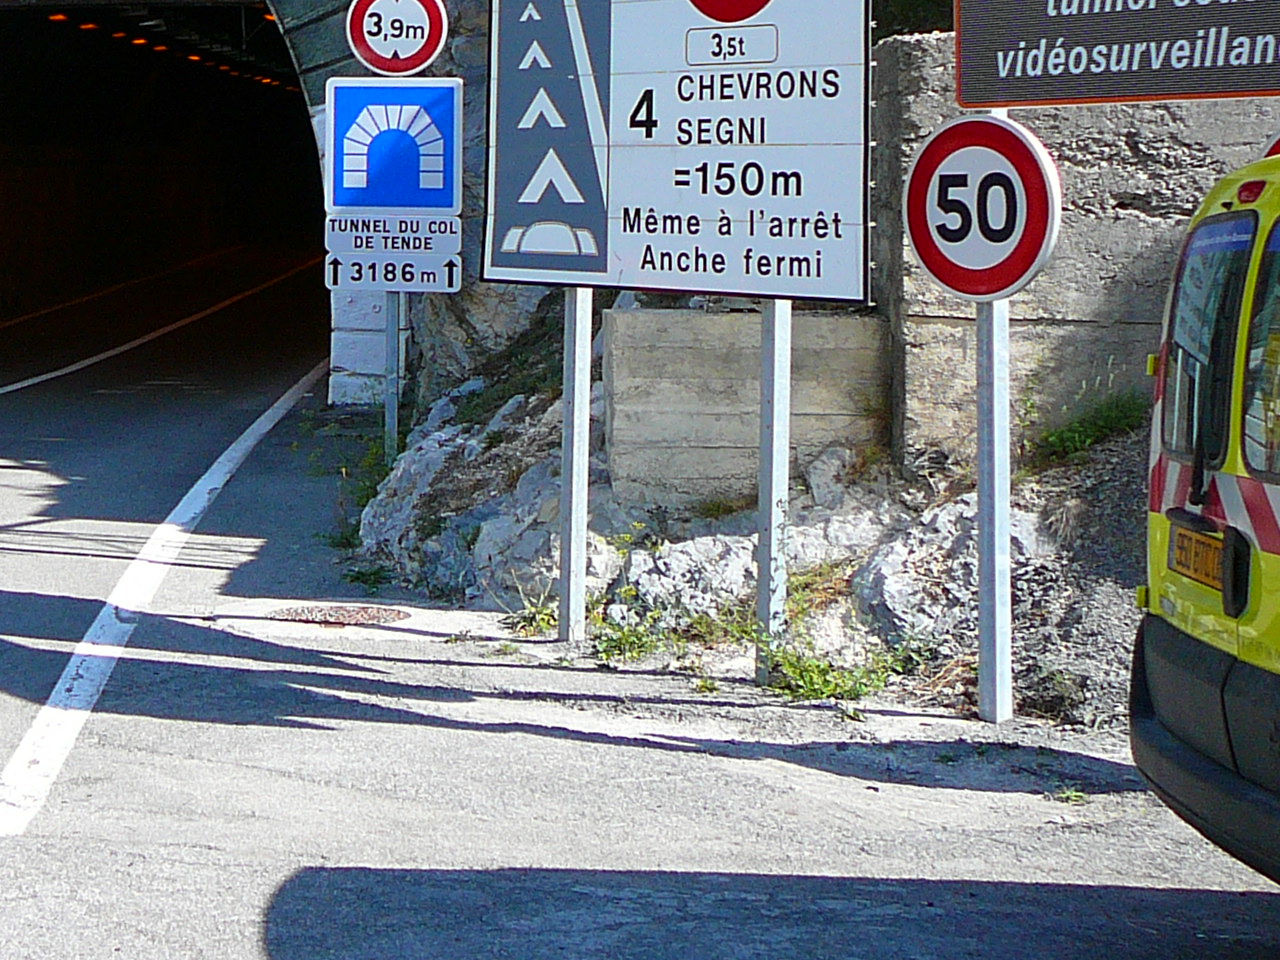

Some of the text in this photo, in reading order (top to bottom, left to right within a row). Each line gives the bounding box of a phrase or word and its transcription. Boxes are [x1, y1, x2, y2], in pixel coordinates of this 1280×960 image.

[366, 11, 425, 42] 3,9m
[711, 33, 746, 60] 3,5t
[997, 26, 1280, 79] vidéosurveillan
[677, 69, 840, 101] CHEVRONS
[629, 89, 658, 139] 4
[677, 117, 766, 145] SEGNI
[622, 207, 843, 239] Même à l'arrêt
[935, 172, 1018, 244] 50
[329, 218, 458, 234] TUNNEL DU COL
[354, 235, 433, 250] DE TENDE
[641, 244, 822, 278] Anche fermi
